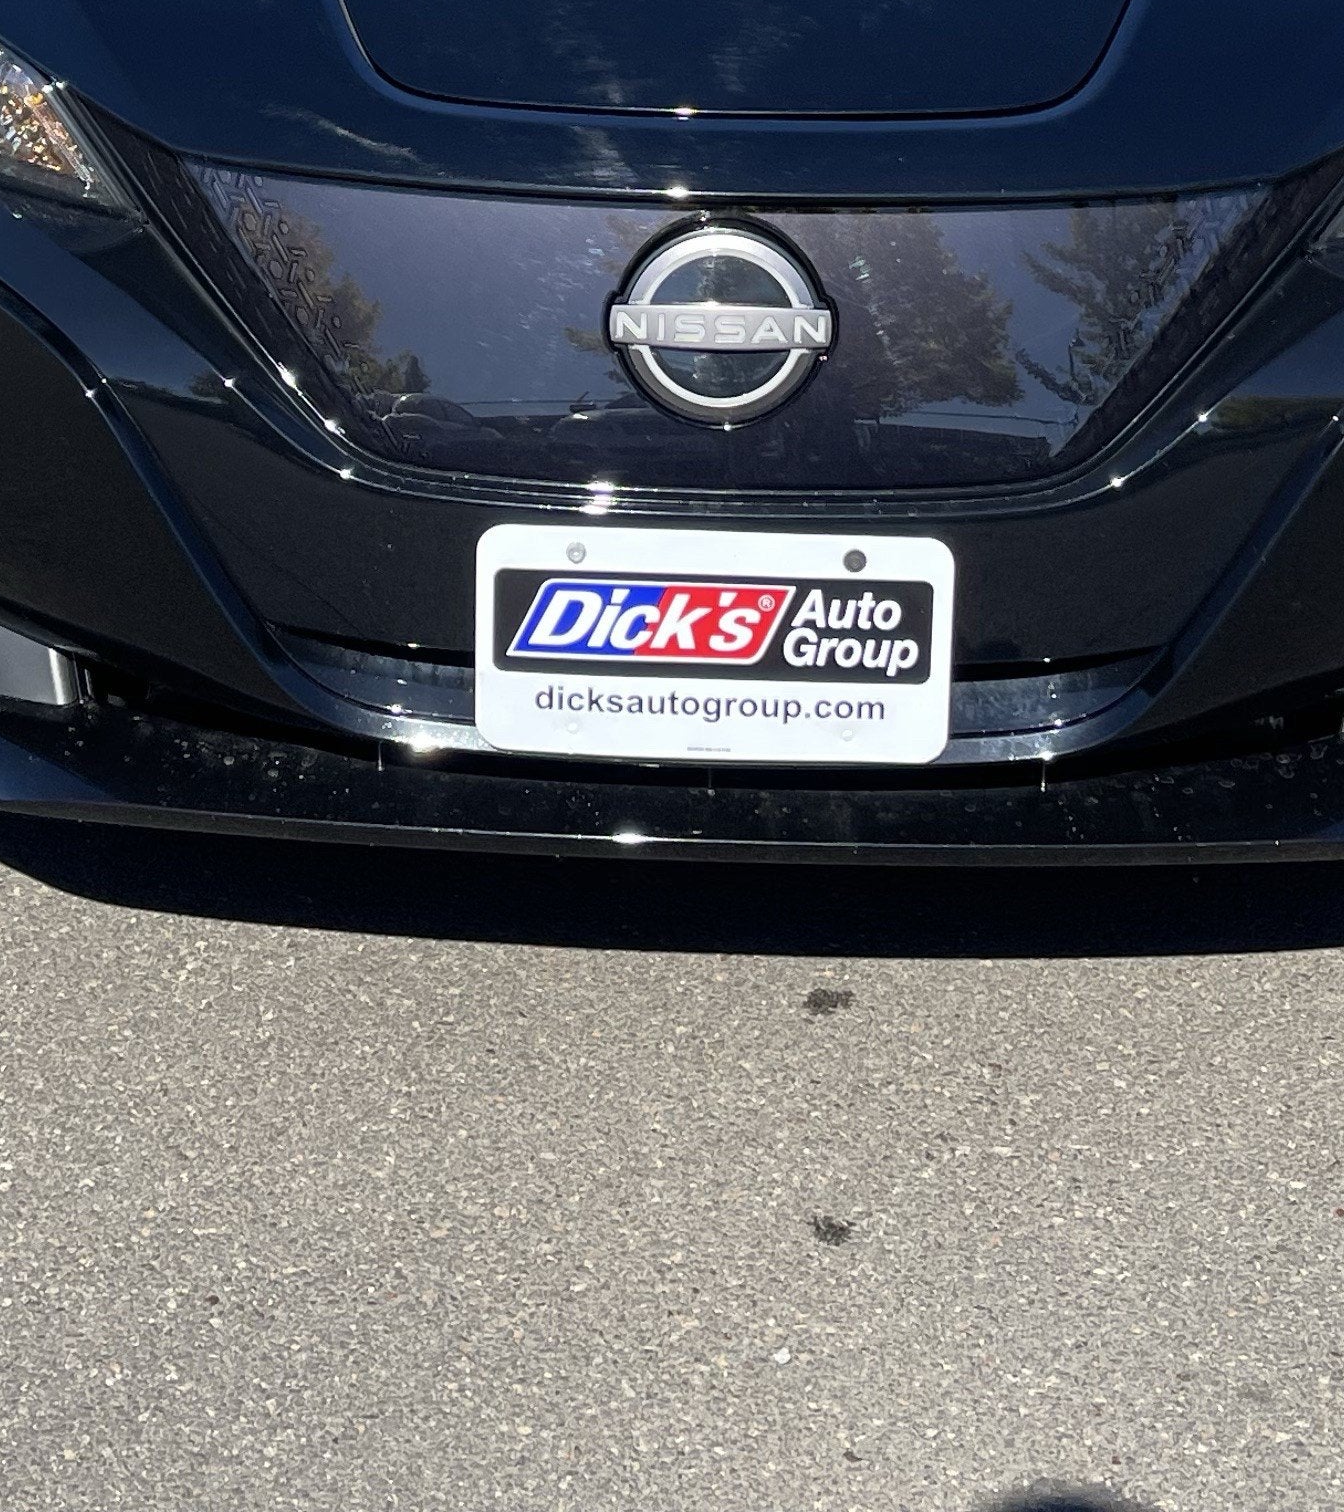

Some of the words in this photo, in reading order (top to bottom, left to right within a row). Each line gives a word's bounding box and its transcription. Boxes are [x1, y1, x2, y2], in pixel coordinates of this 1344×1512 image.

[614, 310, 827, 345] NISSAN
[527, 588, 761, 653] Dick's
[789, 589, 902, 631] Auto
[783, 630, 919, 677] Group
[535, 685, 886, 725] dicksautogroup.com
